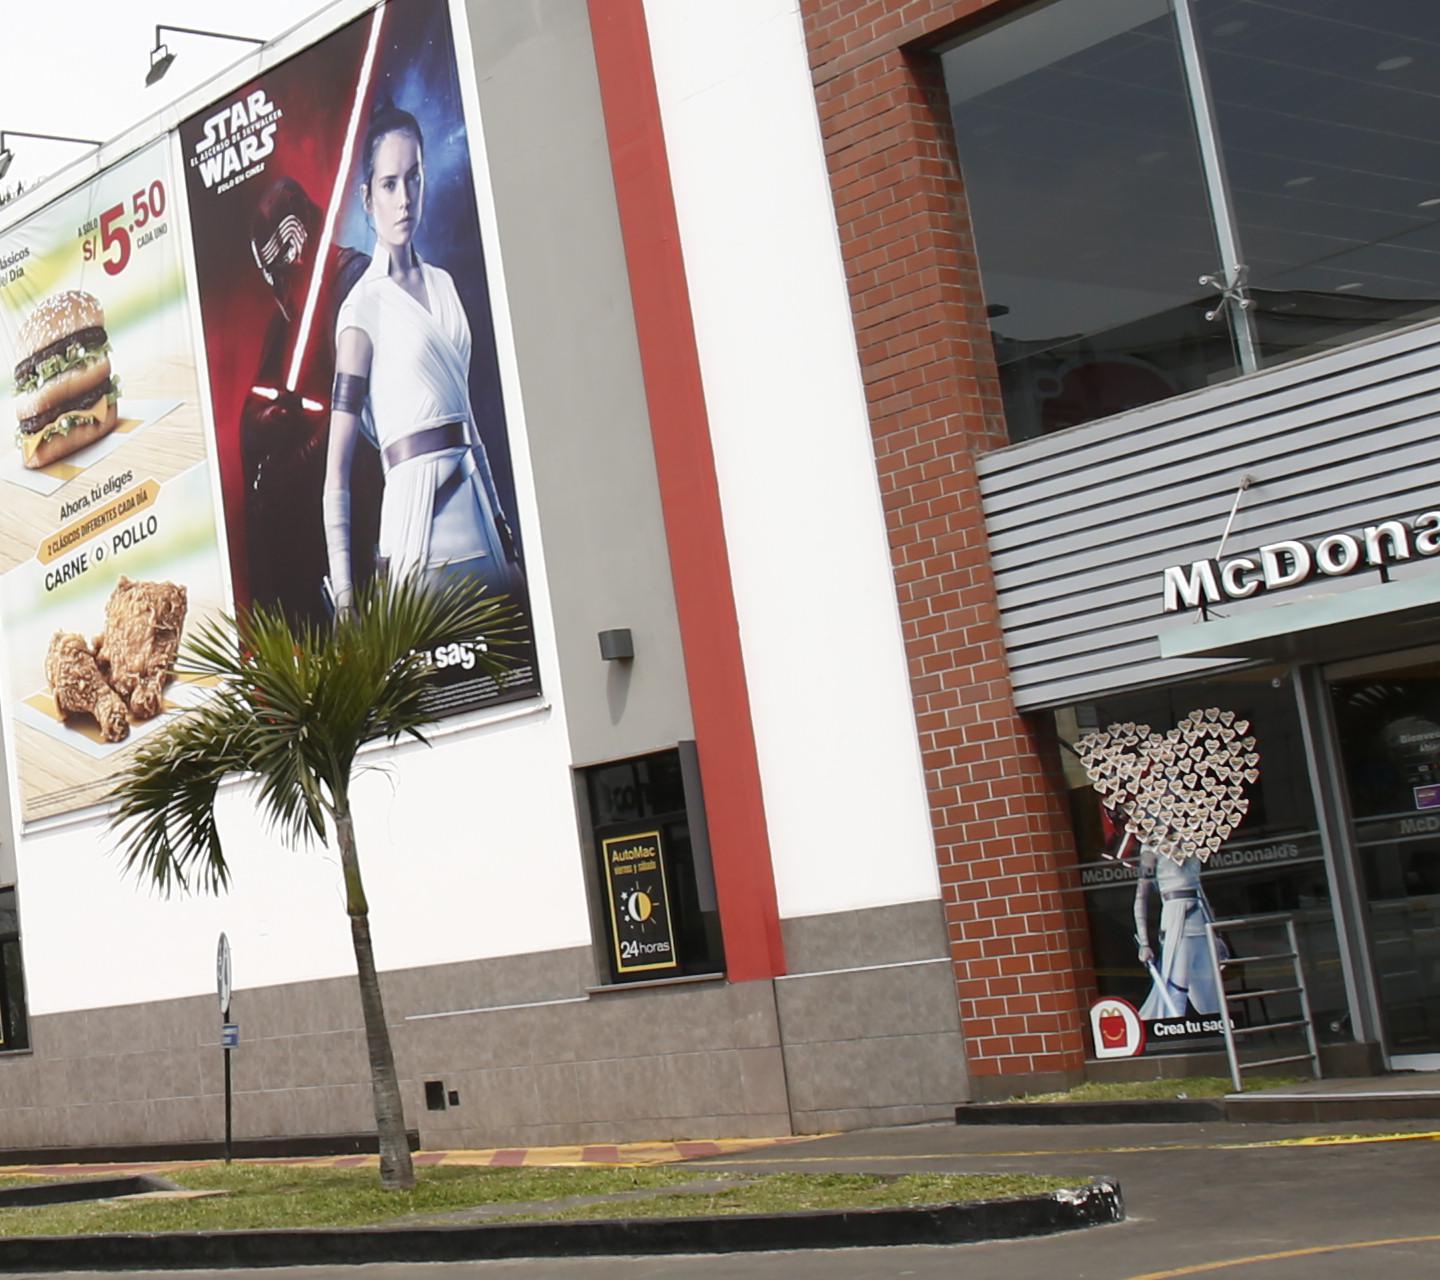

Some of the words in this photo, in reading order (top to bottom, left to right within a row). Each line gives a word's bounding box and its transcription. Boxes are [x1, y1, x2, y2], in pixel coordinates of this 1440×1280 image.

[195, 89, 274, 154] STAR
[198, 122, 277, 189] WARS
[83, 217, 98, 236] SOLO
[9, 264, 25, 282] Día
[60, 495, 91, 521] Ahora,
[91, 482, 102, 502] tú
[103, 470, 133, 495] eliges
[81, 508, 117, 537] DIFERENTES
[117, 499, 135, 516] CADA
[45, 553, 88, 592] CARNE
[112, 515, 158, 555] POLLO
[1209, 841, 1299, 869] McDonald's
[1153, 1022, 1186, 1037] Crea
[1186, 1020, 1201, 1033] tu
